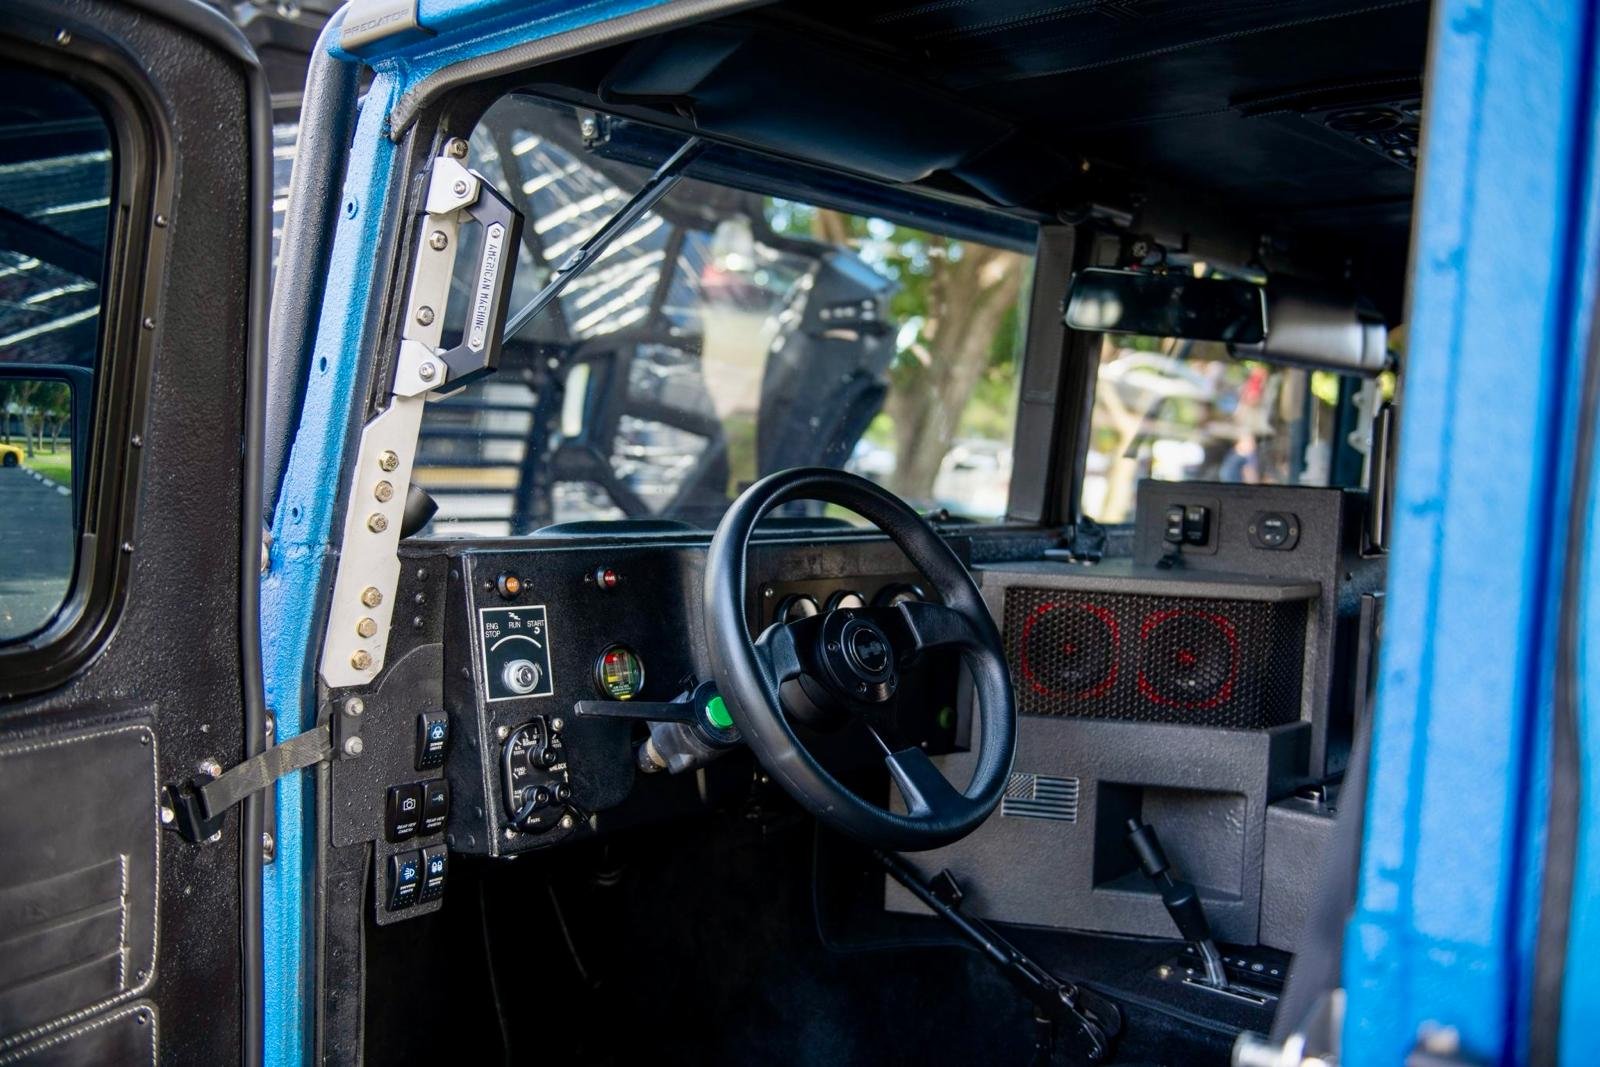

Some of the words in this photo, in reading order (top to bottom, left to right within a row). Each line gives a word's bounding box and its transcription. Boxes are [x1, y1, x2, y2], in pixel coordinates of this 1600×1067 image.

[344, 8, 409, 36] PREDATOR
[484, 244, 498, 292] AMERICAN
[474, 292, 489, 331] MACHINE
[486, 622, 499, 630] ENG
[508, 621, 521, 629] RUN
[527, 619, 545, 627] START
[485, 630, 500, 638] STOP
